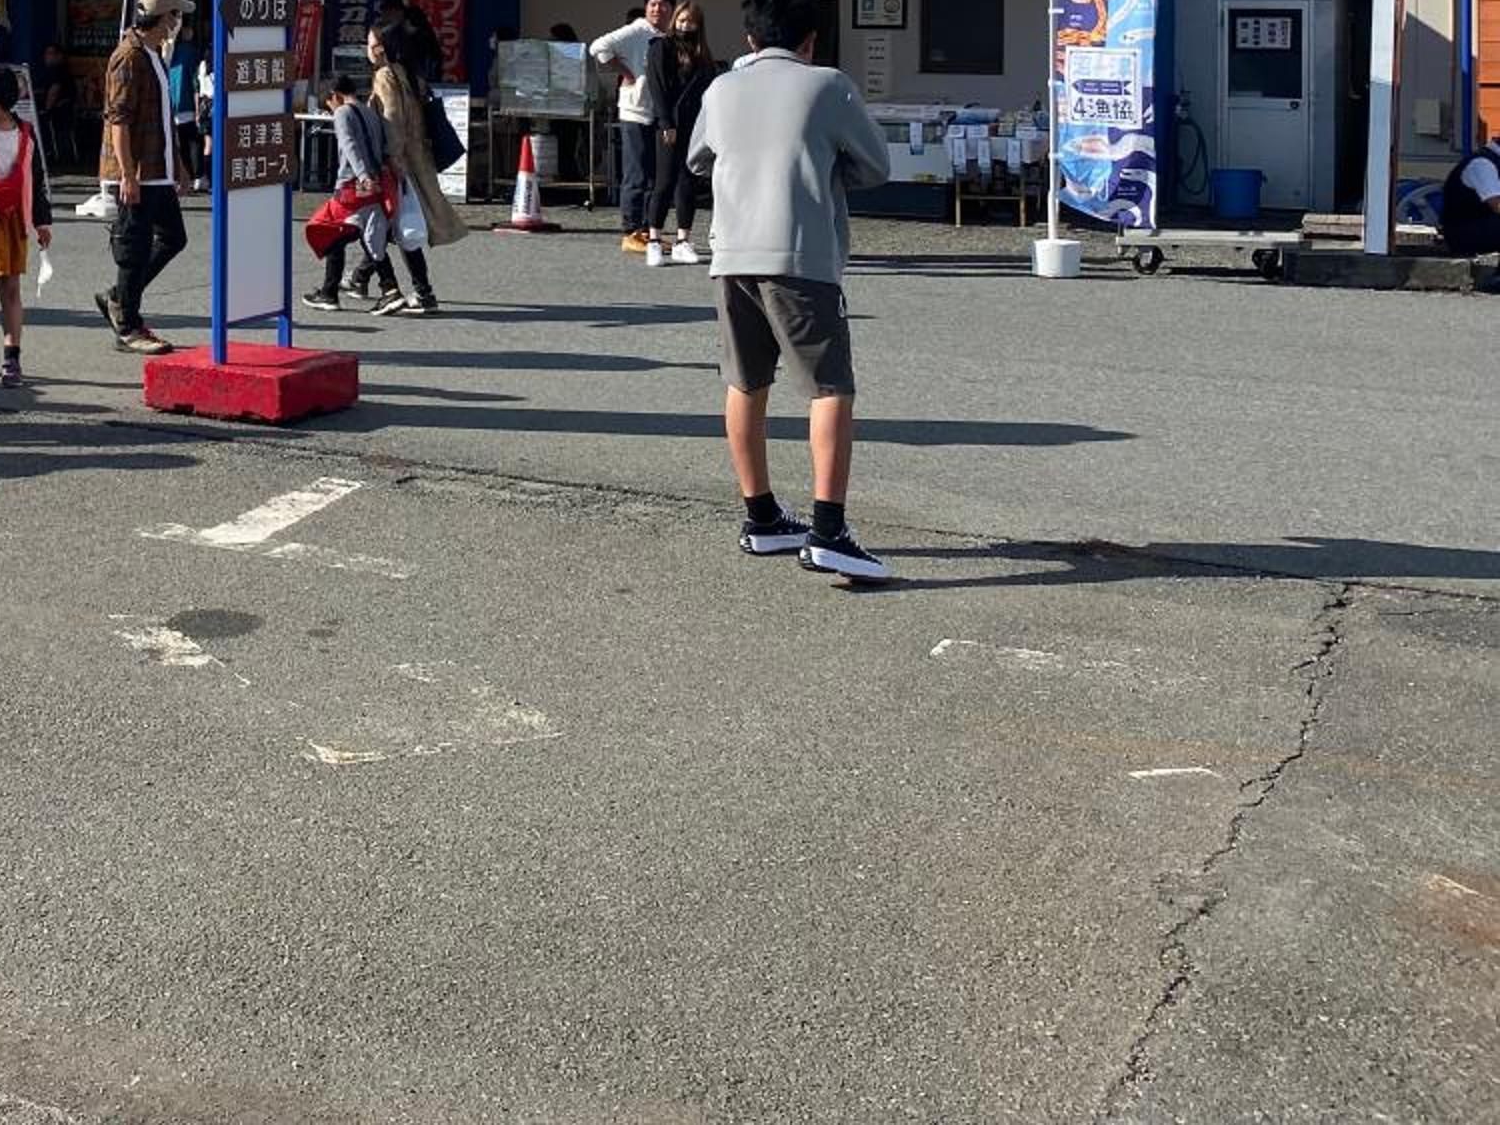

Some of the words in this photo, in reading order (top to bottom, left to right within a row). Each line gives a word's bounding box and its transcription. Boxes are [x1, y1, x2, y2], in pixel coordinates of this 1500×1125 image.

[236, 58, 285, 84] 遊覧船
[231, 154, 290, 182] 周遊コース
